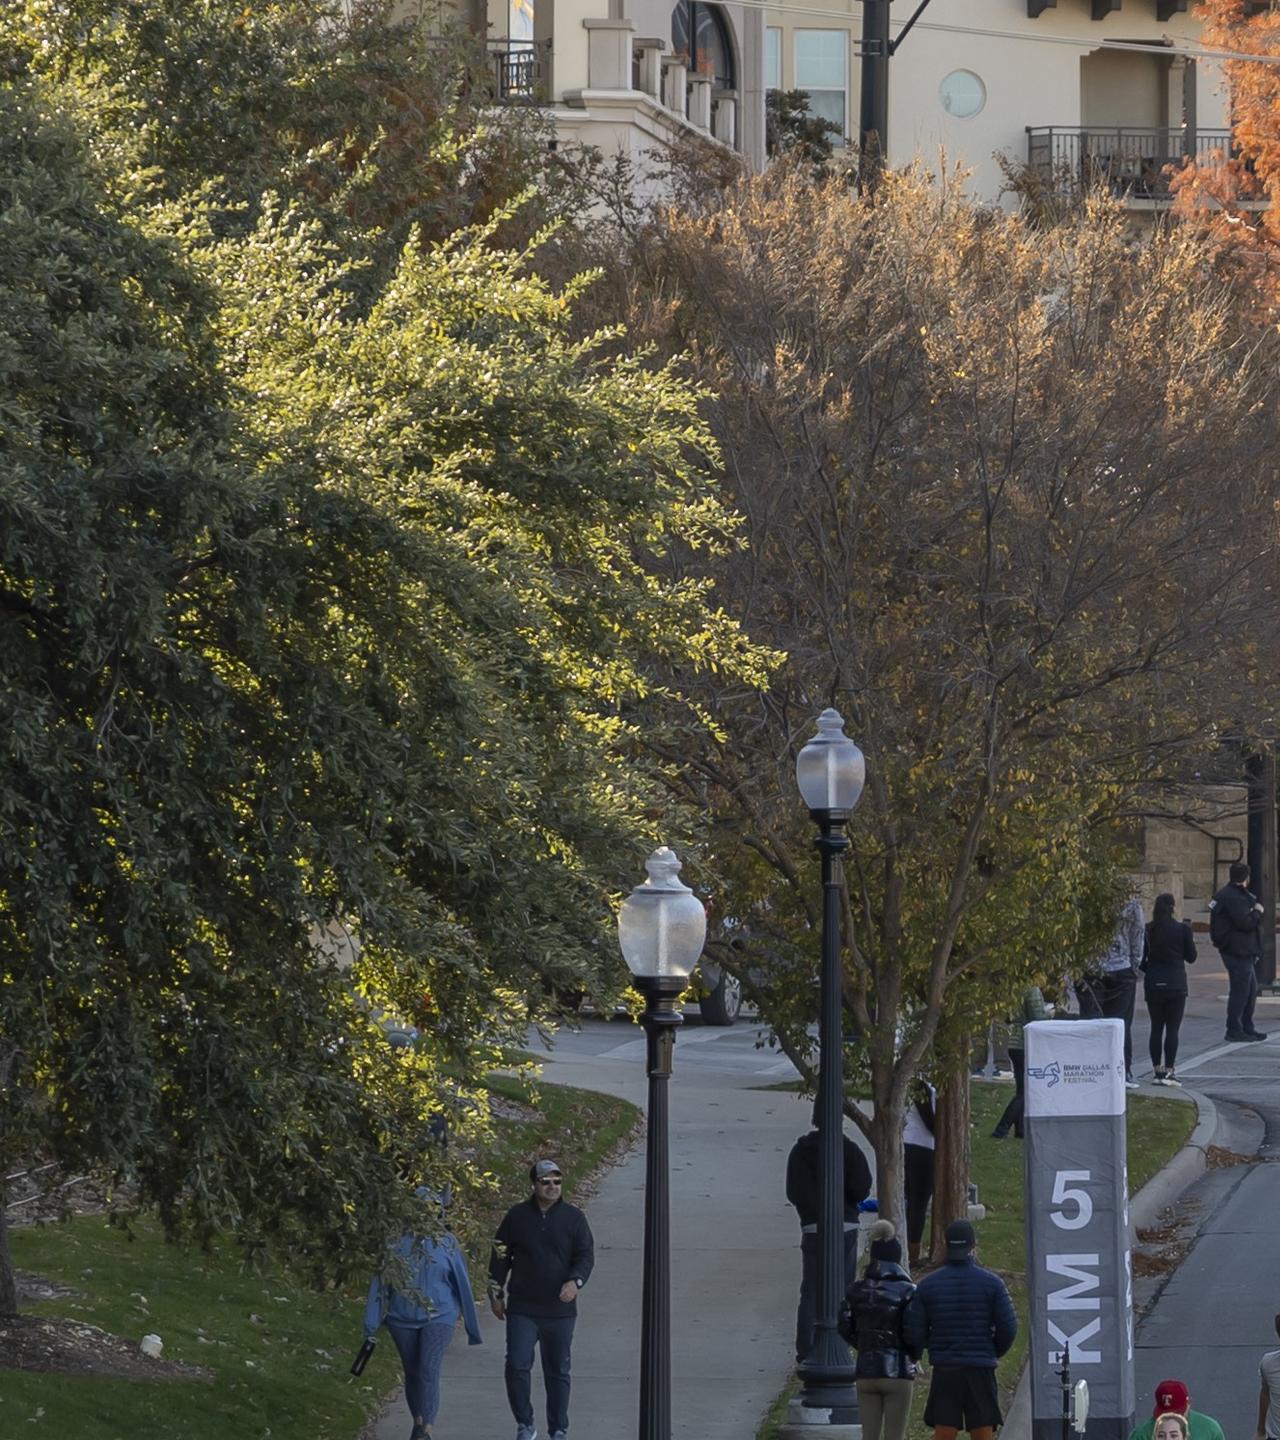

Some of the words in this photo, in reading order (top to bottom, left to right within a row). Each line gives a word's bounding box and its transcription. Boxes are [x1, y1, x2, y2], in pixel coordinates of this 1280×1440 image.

[1050, 1170, 1093, 1230] 5
[1046, 1254, 1101, 1364] KM
[1162, 1394, 1172, 1405] T
